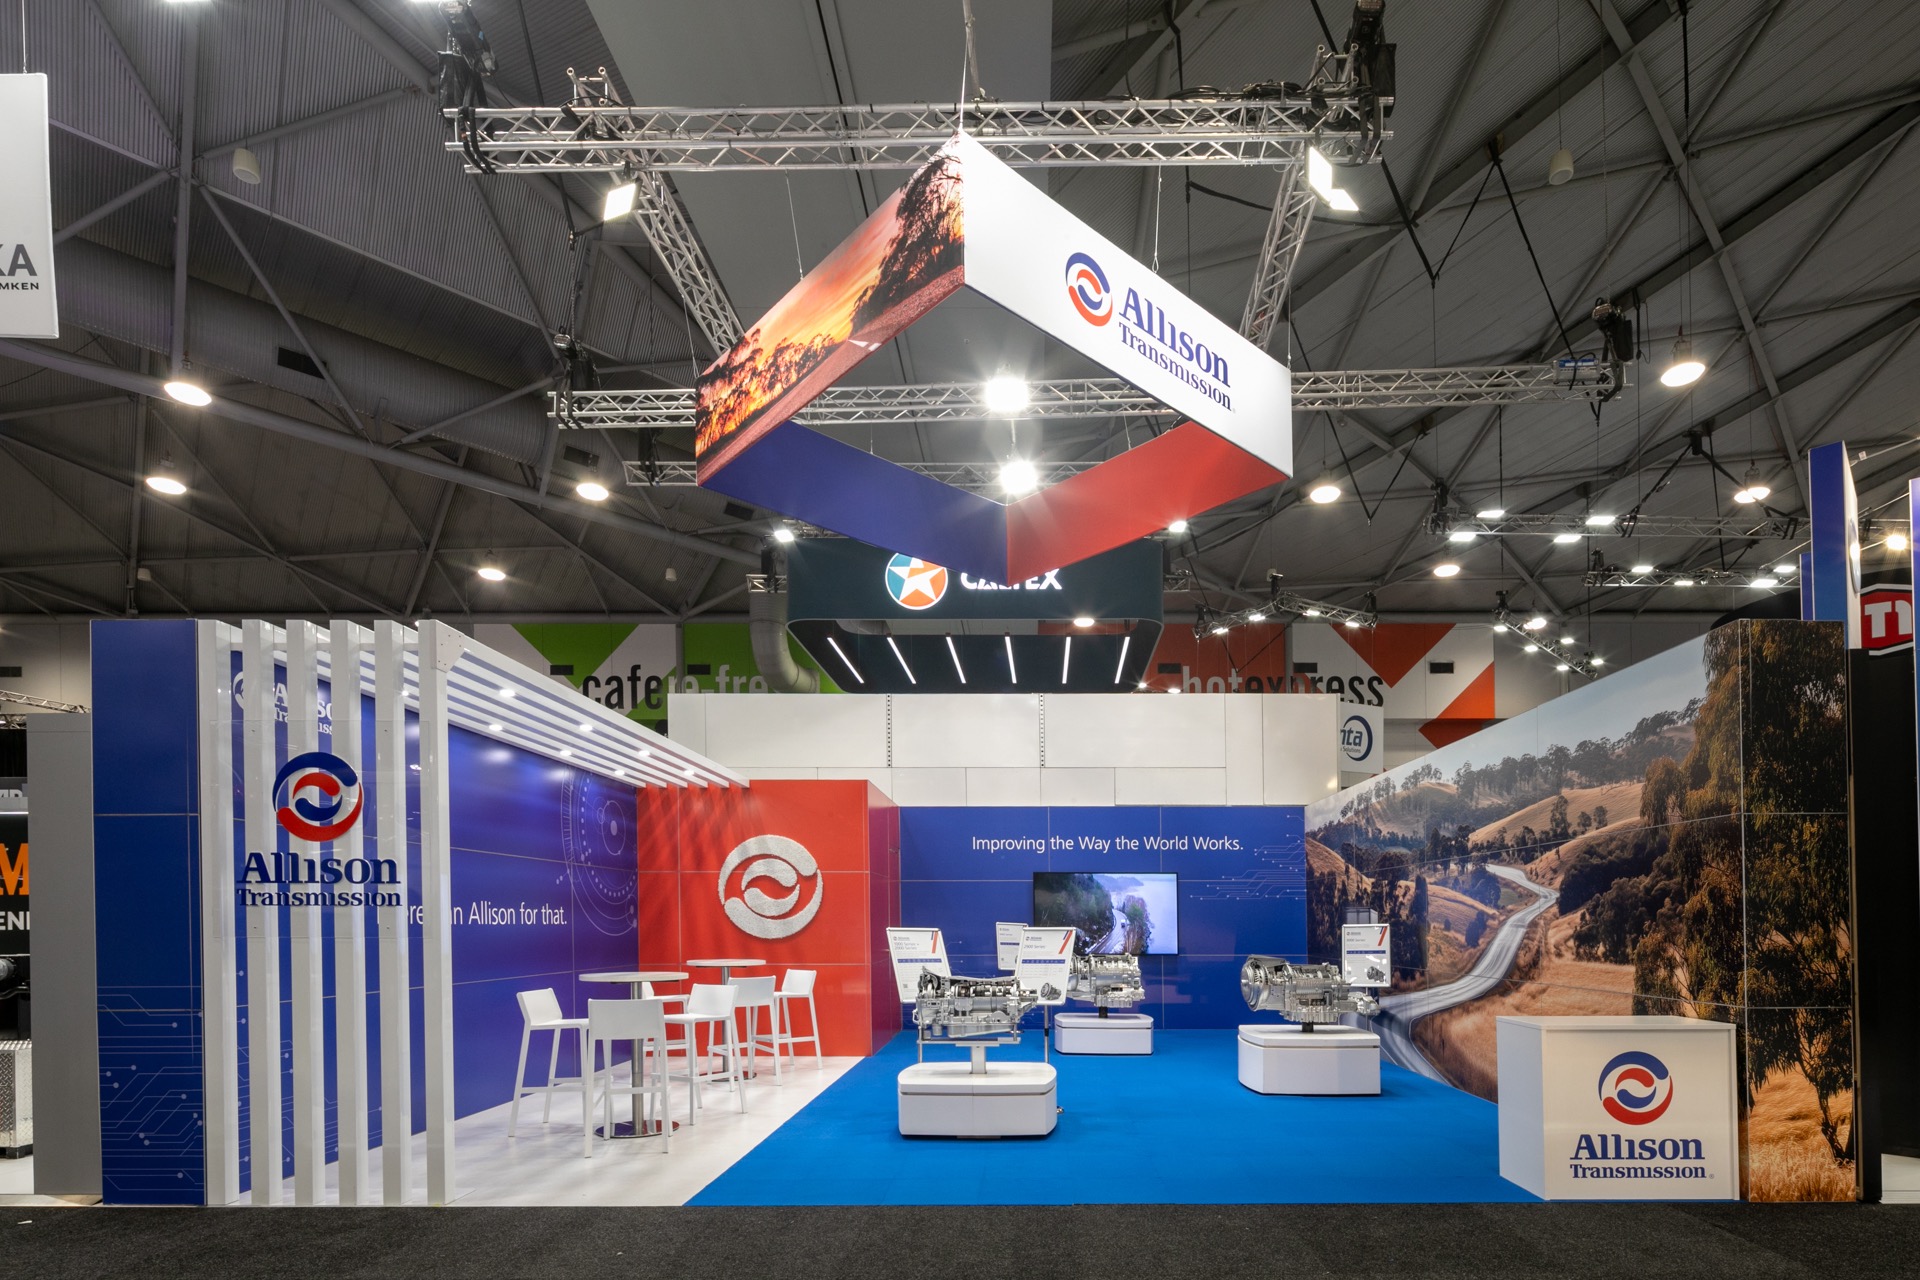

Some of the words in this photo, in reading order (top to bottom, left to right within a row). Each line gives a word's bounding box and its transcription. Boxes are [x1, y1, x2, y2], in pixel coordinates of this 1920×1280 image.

[1119, 287, 1231, 388] Allison
[1119, 321, 1232, 412] Transmission
[960, 569, 1063, 590] CEX
[972, 836, 1045, 854] Improving
[1050, 836, 1075, 850] the
[1078, 836, 1111, 854] Way
[1115, 836, 1140, 850] the
[1143, 835, 1188, 850] World
[1192, 836, 1244, 850] Works.
[236, 852, 402, 885] Allison
[236, 888, 403, 907] Transmission
[468, 900, 516, 925] Allison
[519, 901, 538, 925] for
[541, 903, 567, 925] that.
[1570, 1134, 1705, 1160] Allison
[1570, 1164, 1707, 1179] Transmission
